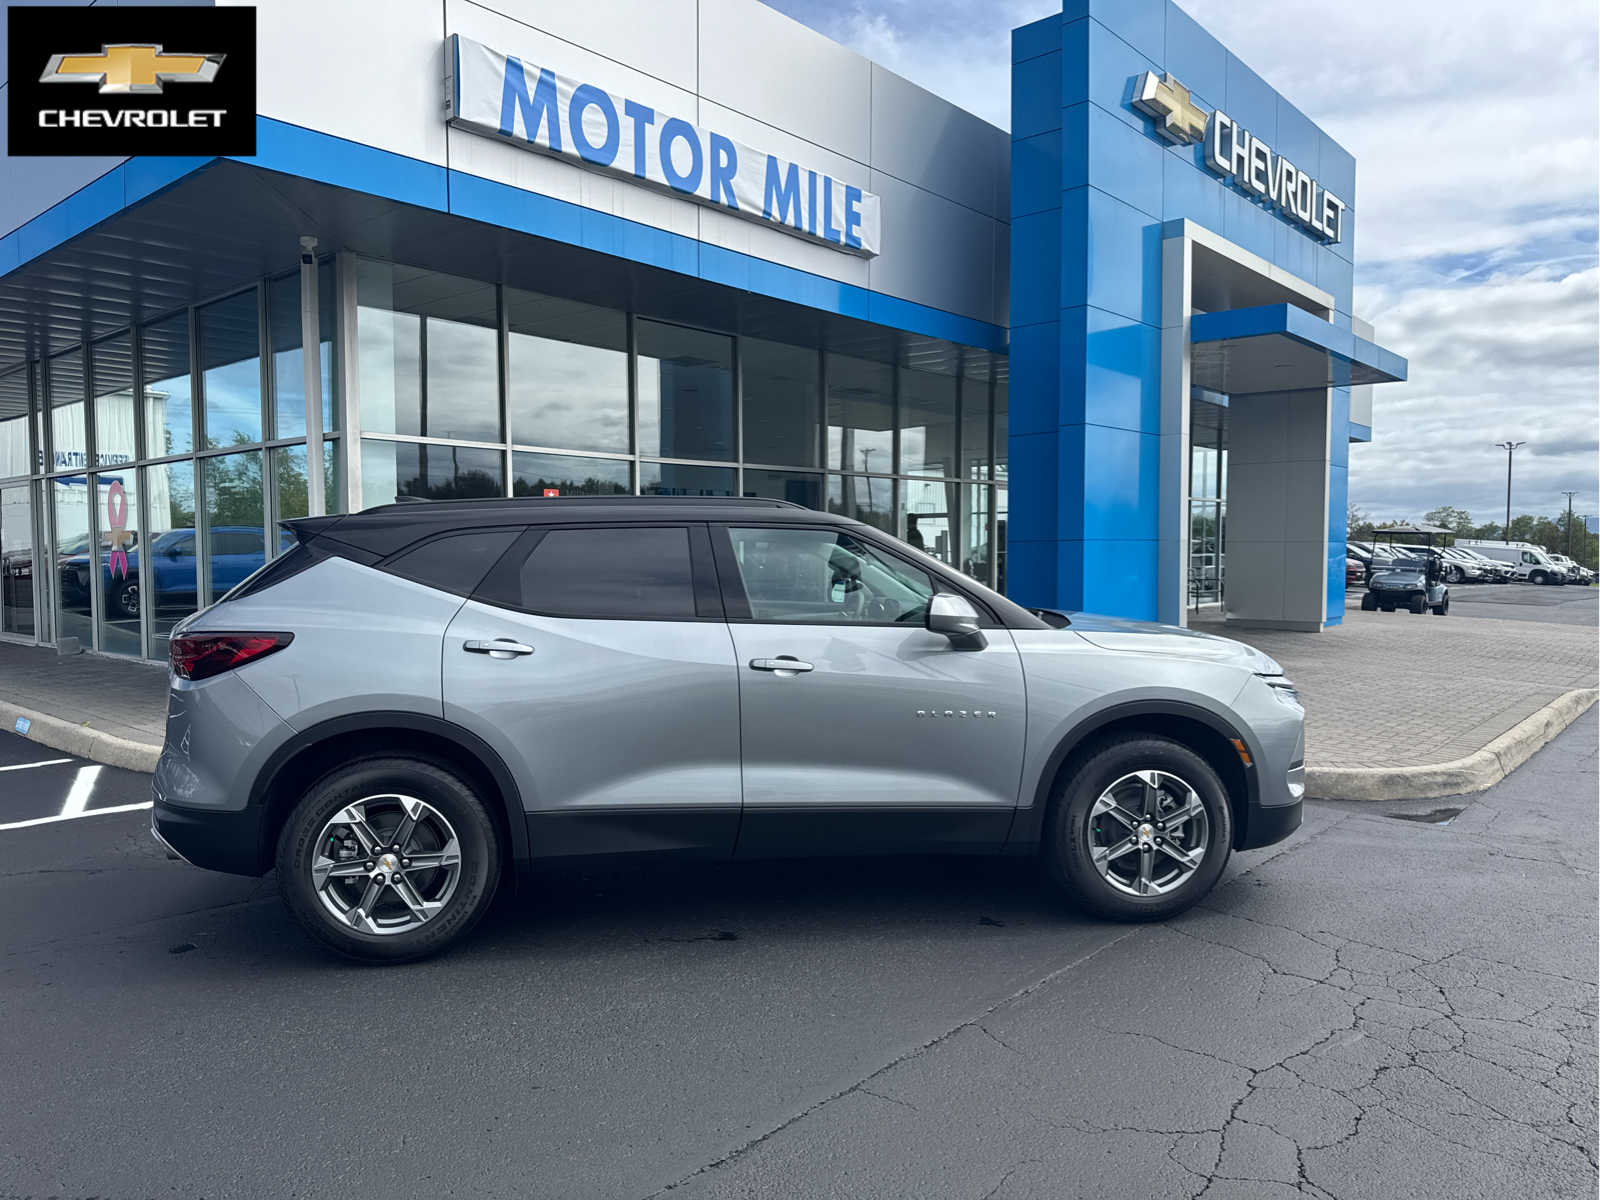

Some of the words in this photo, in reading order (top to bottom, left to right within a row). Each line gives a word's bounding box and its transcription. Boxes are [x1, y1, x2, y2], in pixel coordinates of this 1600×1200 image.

[497, 54, 740, 211] MOTOR
[762, 153, 862, 250] MILE
[1211, 109, 1346, 243] CHEVROLET
[915, 709, 997, 719] BLAZER
